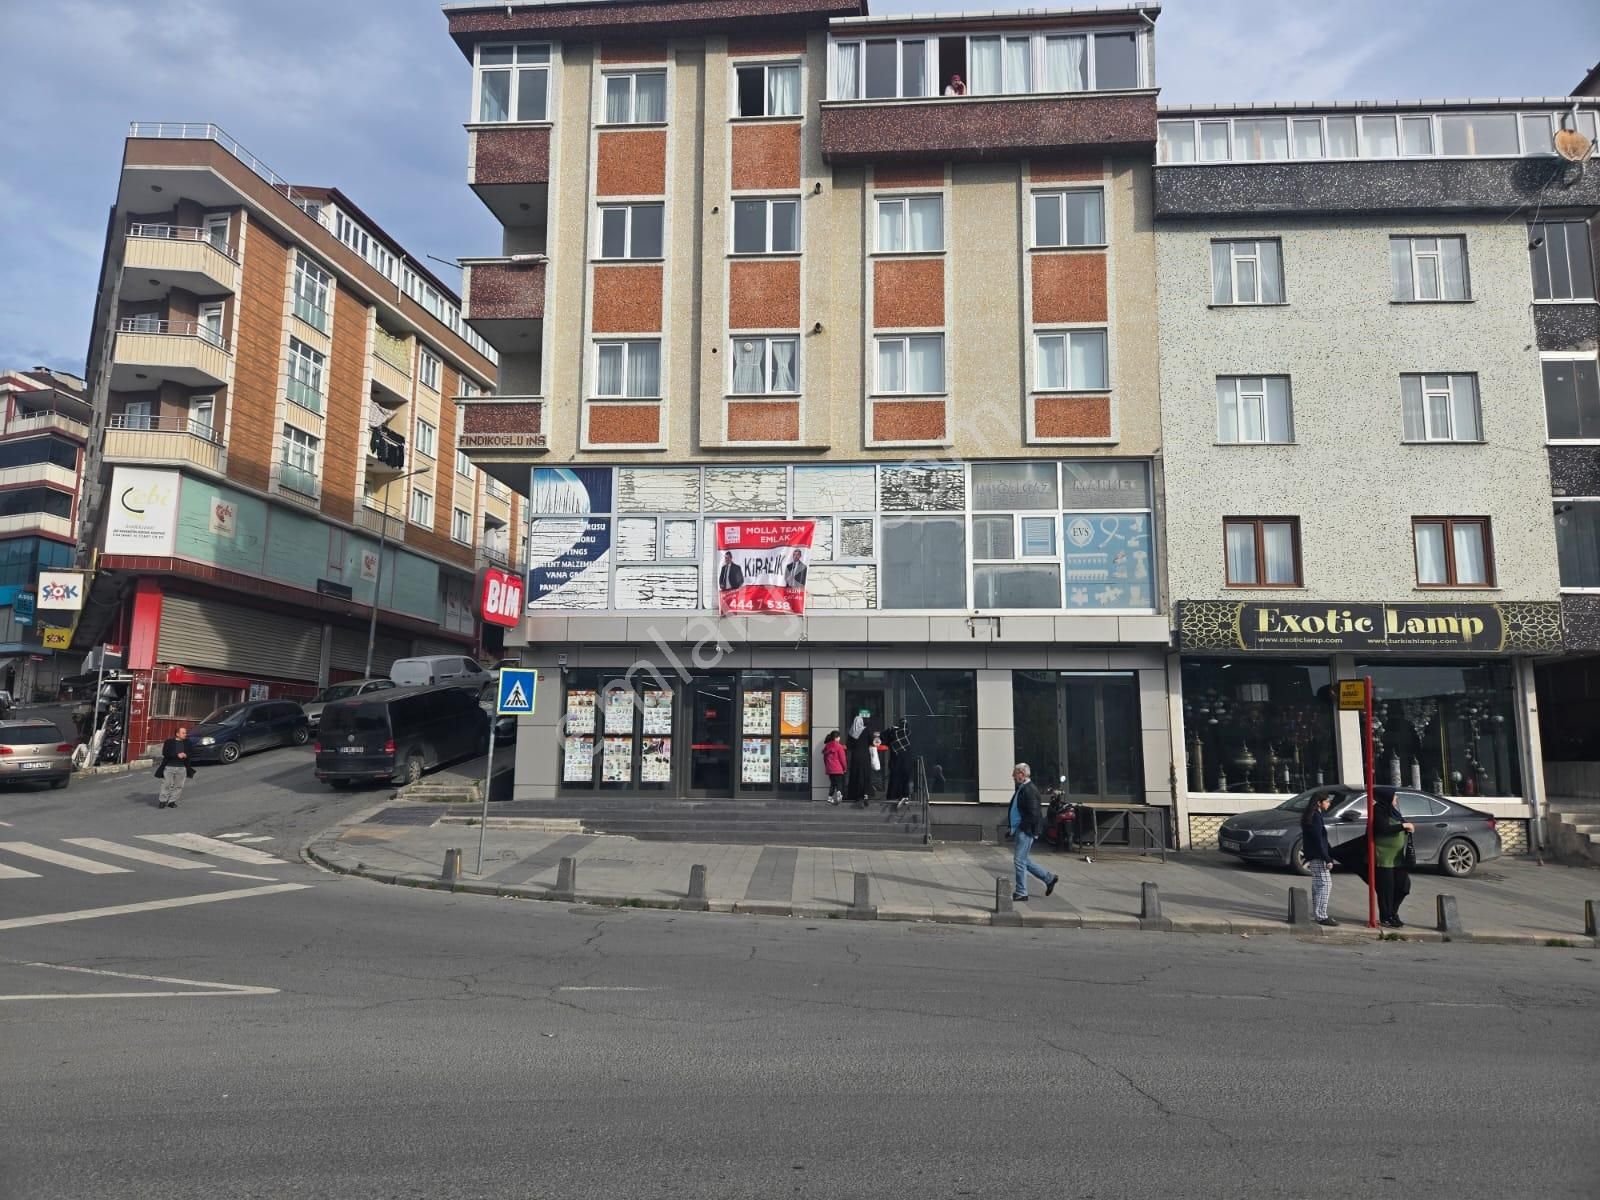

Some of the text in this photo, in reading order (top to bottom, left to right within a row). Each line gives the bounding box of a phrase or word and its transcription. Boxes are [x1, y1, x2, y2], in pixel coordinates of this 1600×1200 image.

[1072, 527, 1089, 537] EVS
[760, 534, 790, 543] EMLAK
[545, 571, 568, 579] VANA
[729, 598, 754, 610] 444
[767, 601, 791, 611] 538
[1254, 607, 1484, 643] Exotic Lamp
